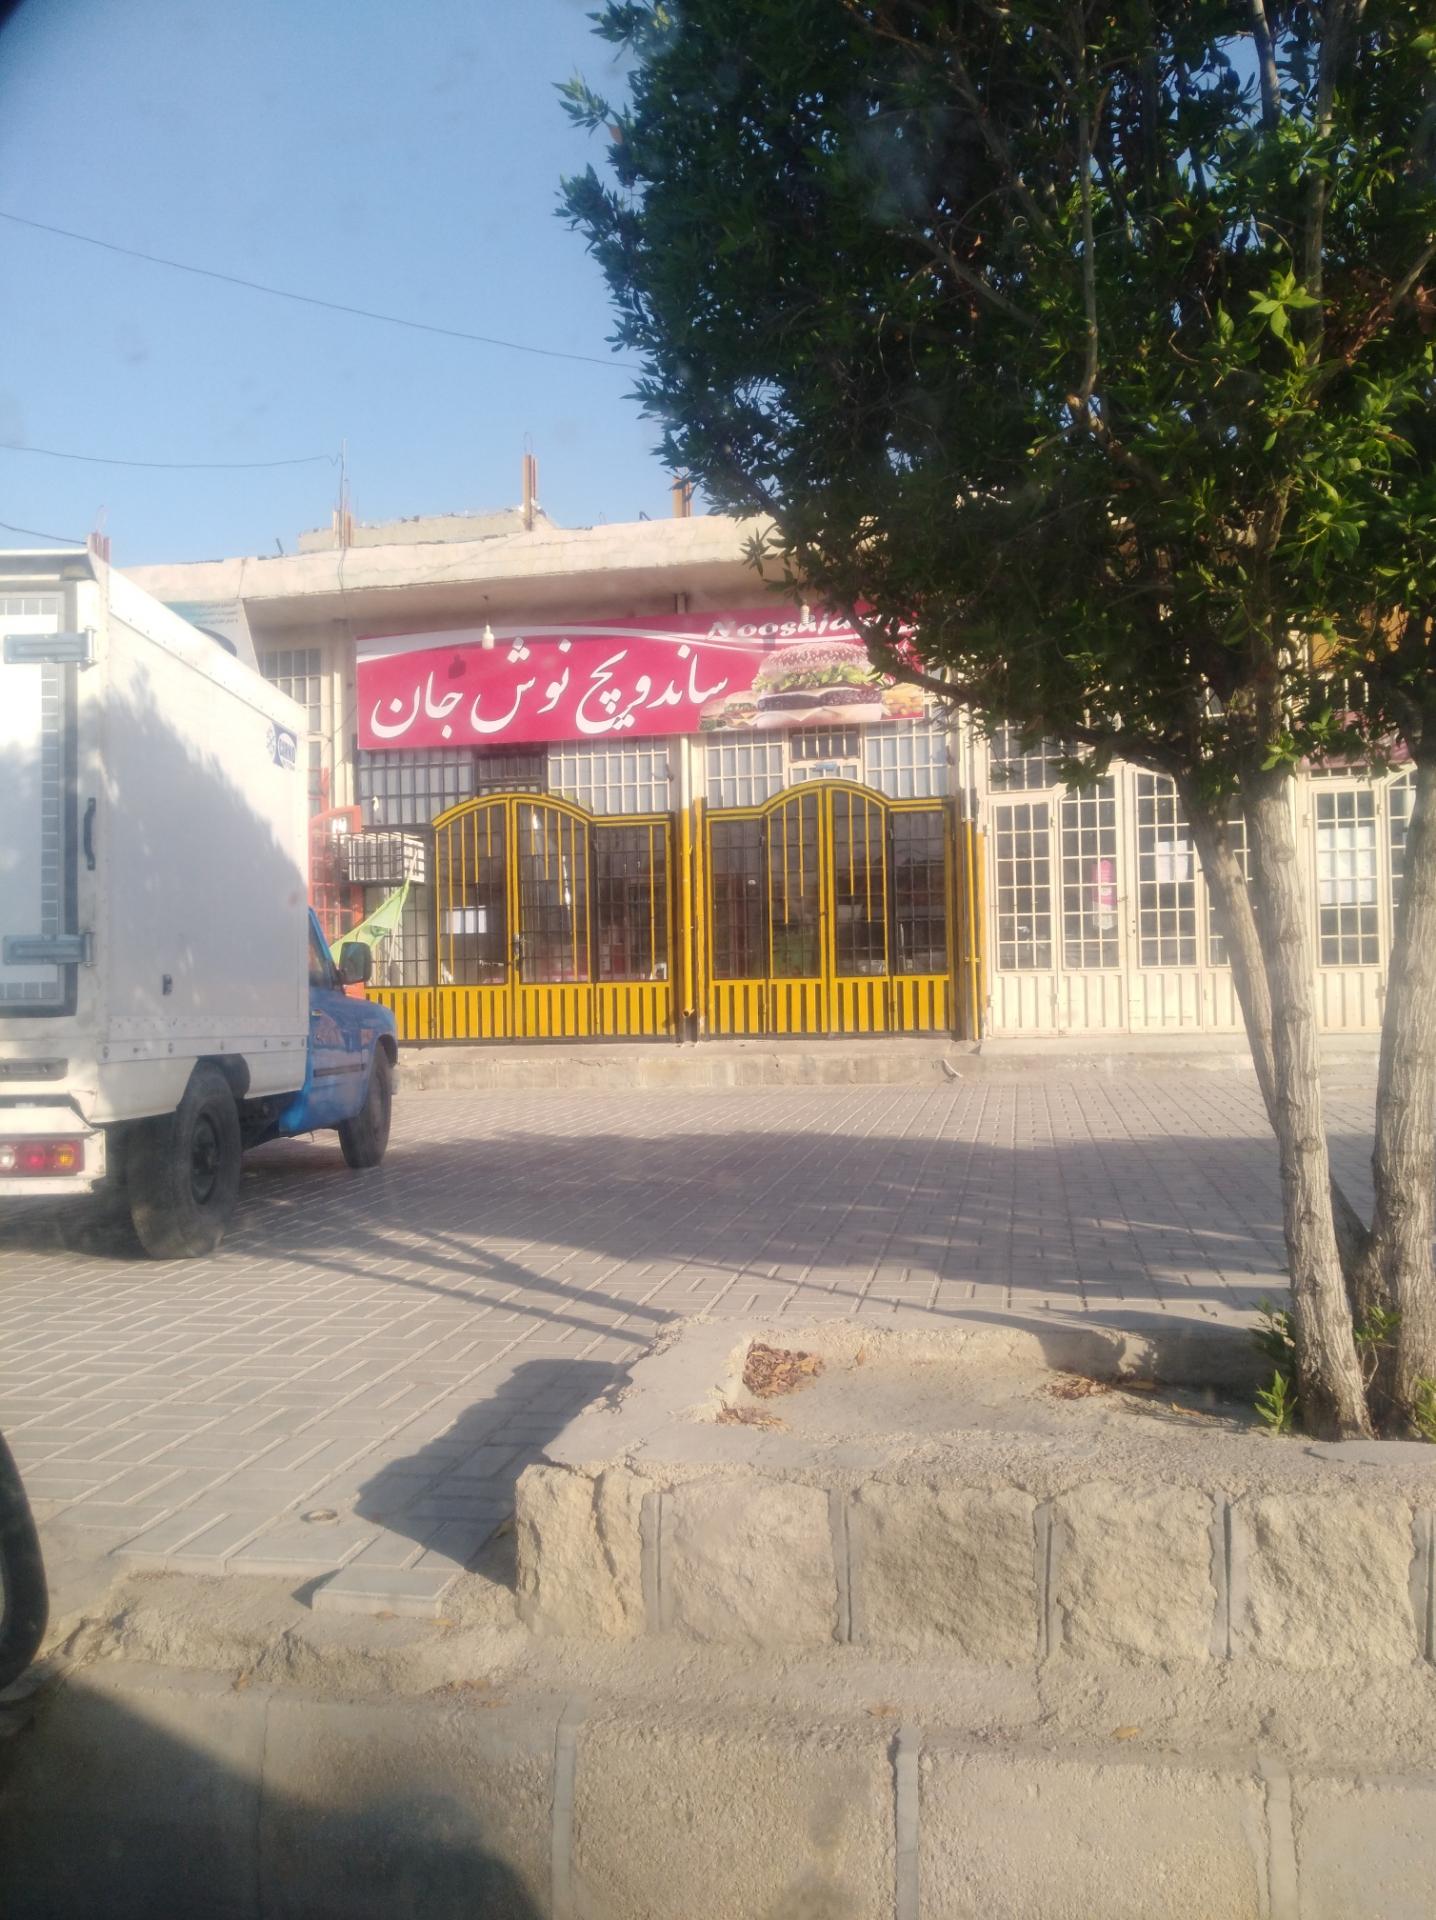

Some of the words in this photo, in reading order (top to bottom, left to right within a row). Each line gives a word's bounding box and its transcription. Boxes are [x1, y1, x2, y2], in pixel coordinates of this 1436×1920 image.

[370, 671, 464, 740] جان
[470, 637, 570, 734] نوش
[575, 644, 728, 735] ساندویچ
